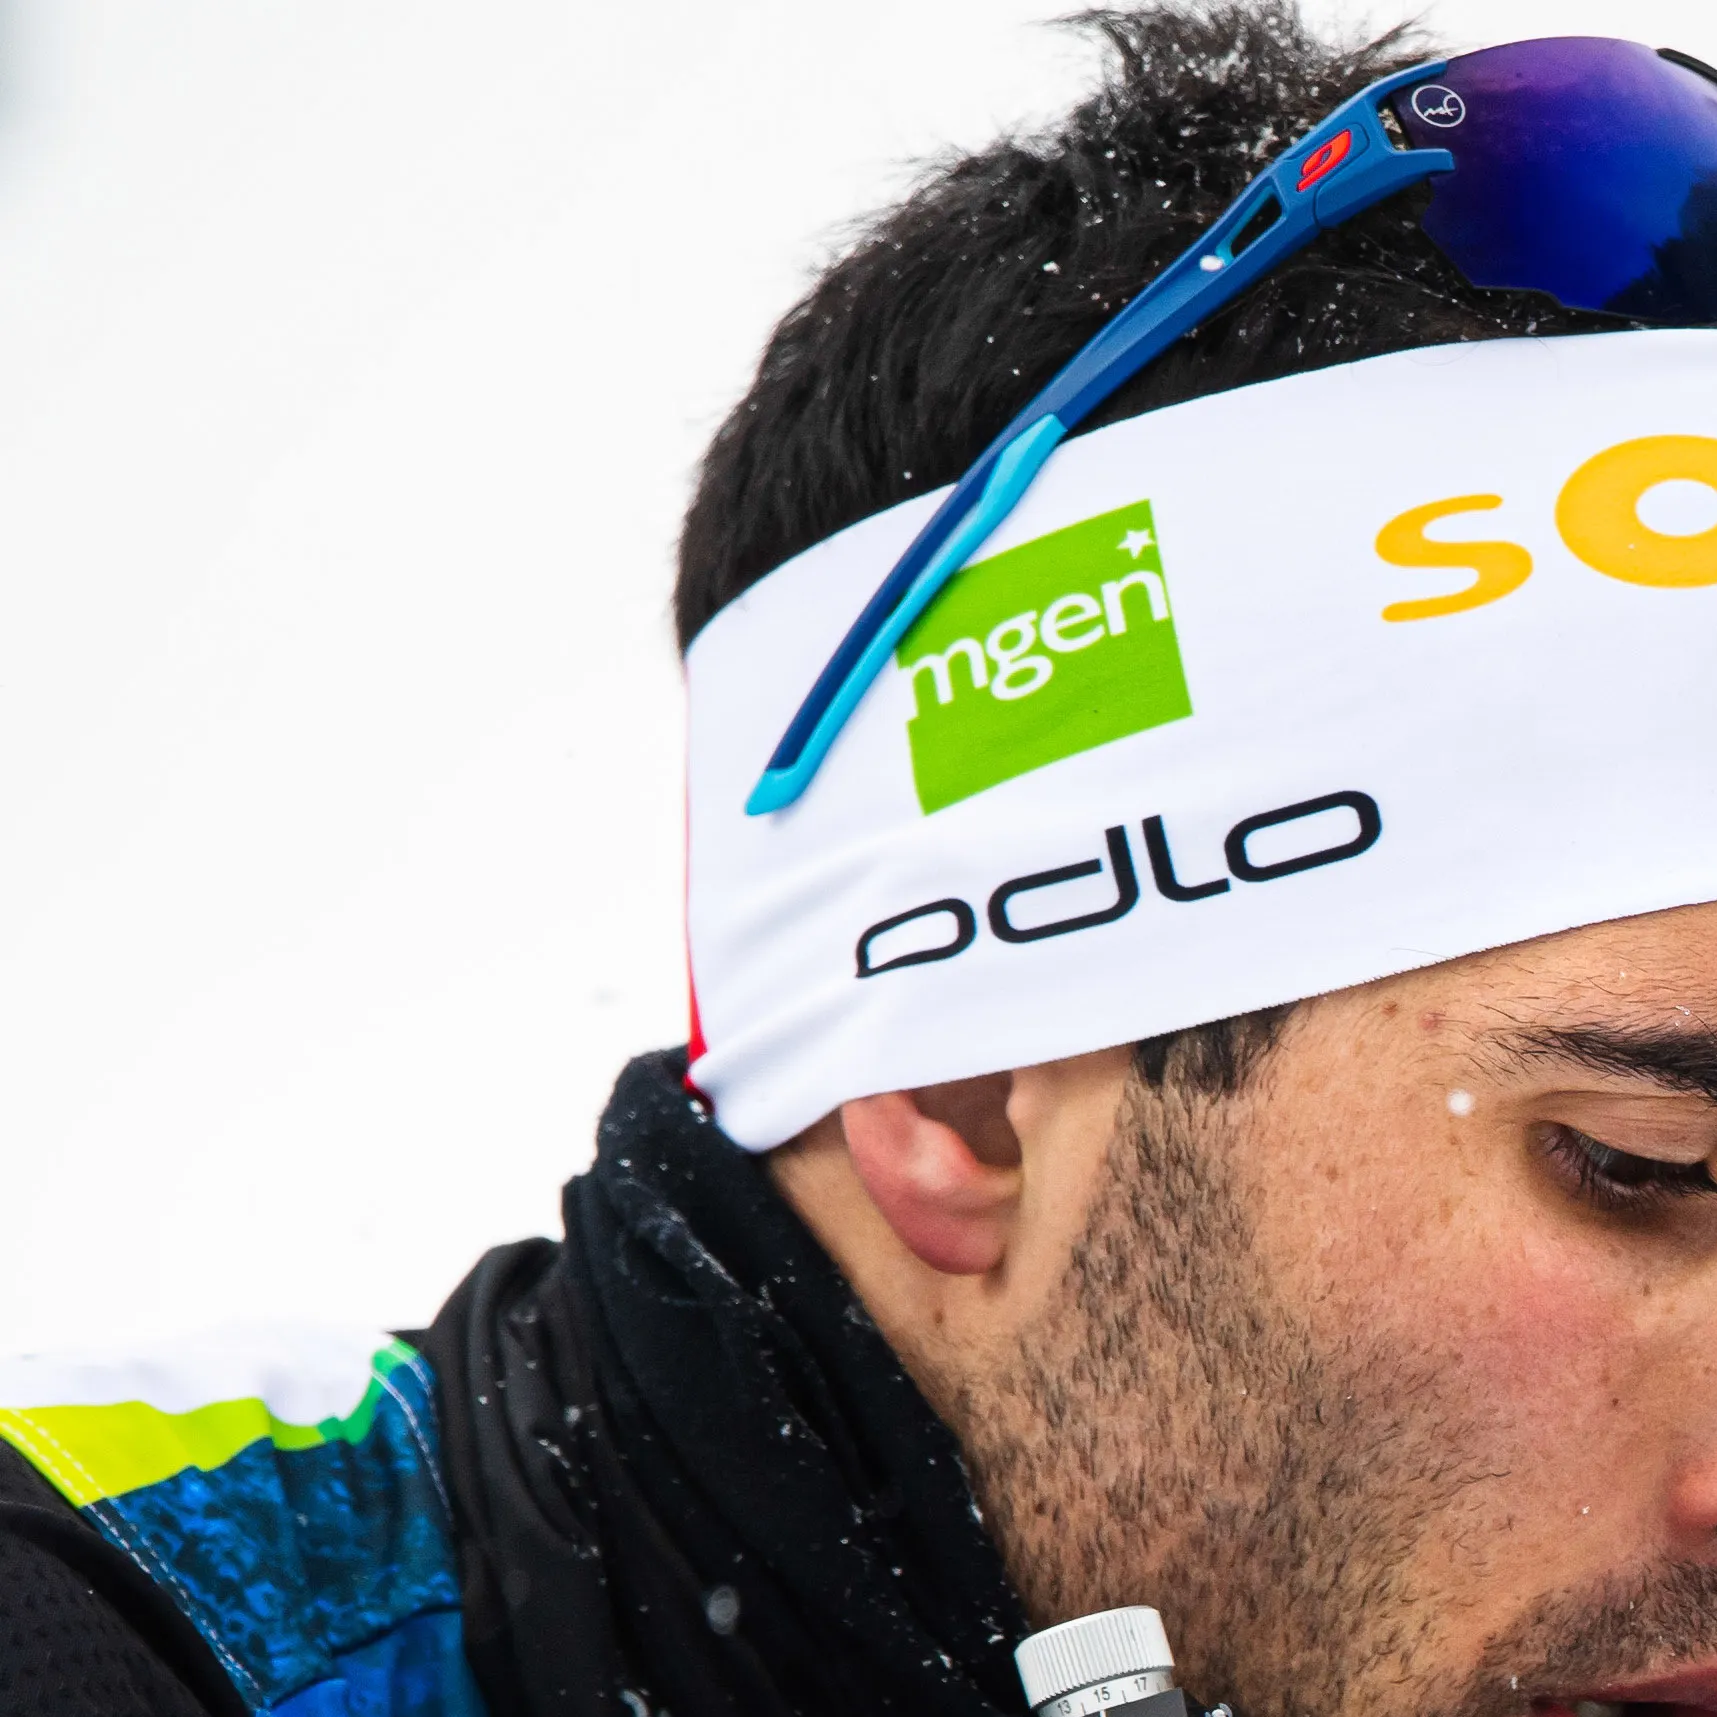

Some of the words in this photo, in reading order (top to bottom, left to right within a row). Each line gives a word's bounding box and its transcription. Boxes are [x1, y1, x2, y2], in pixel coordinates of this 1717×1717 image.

[902, 569, 1170, 721] mgen
[855, 789, 1382, 979] odlo
[1057, 1699, 1072, 1716] 13
[1093, 1686, 1111, 1703] 15
[1133, 1676, 1147, 1692] 17
